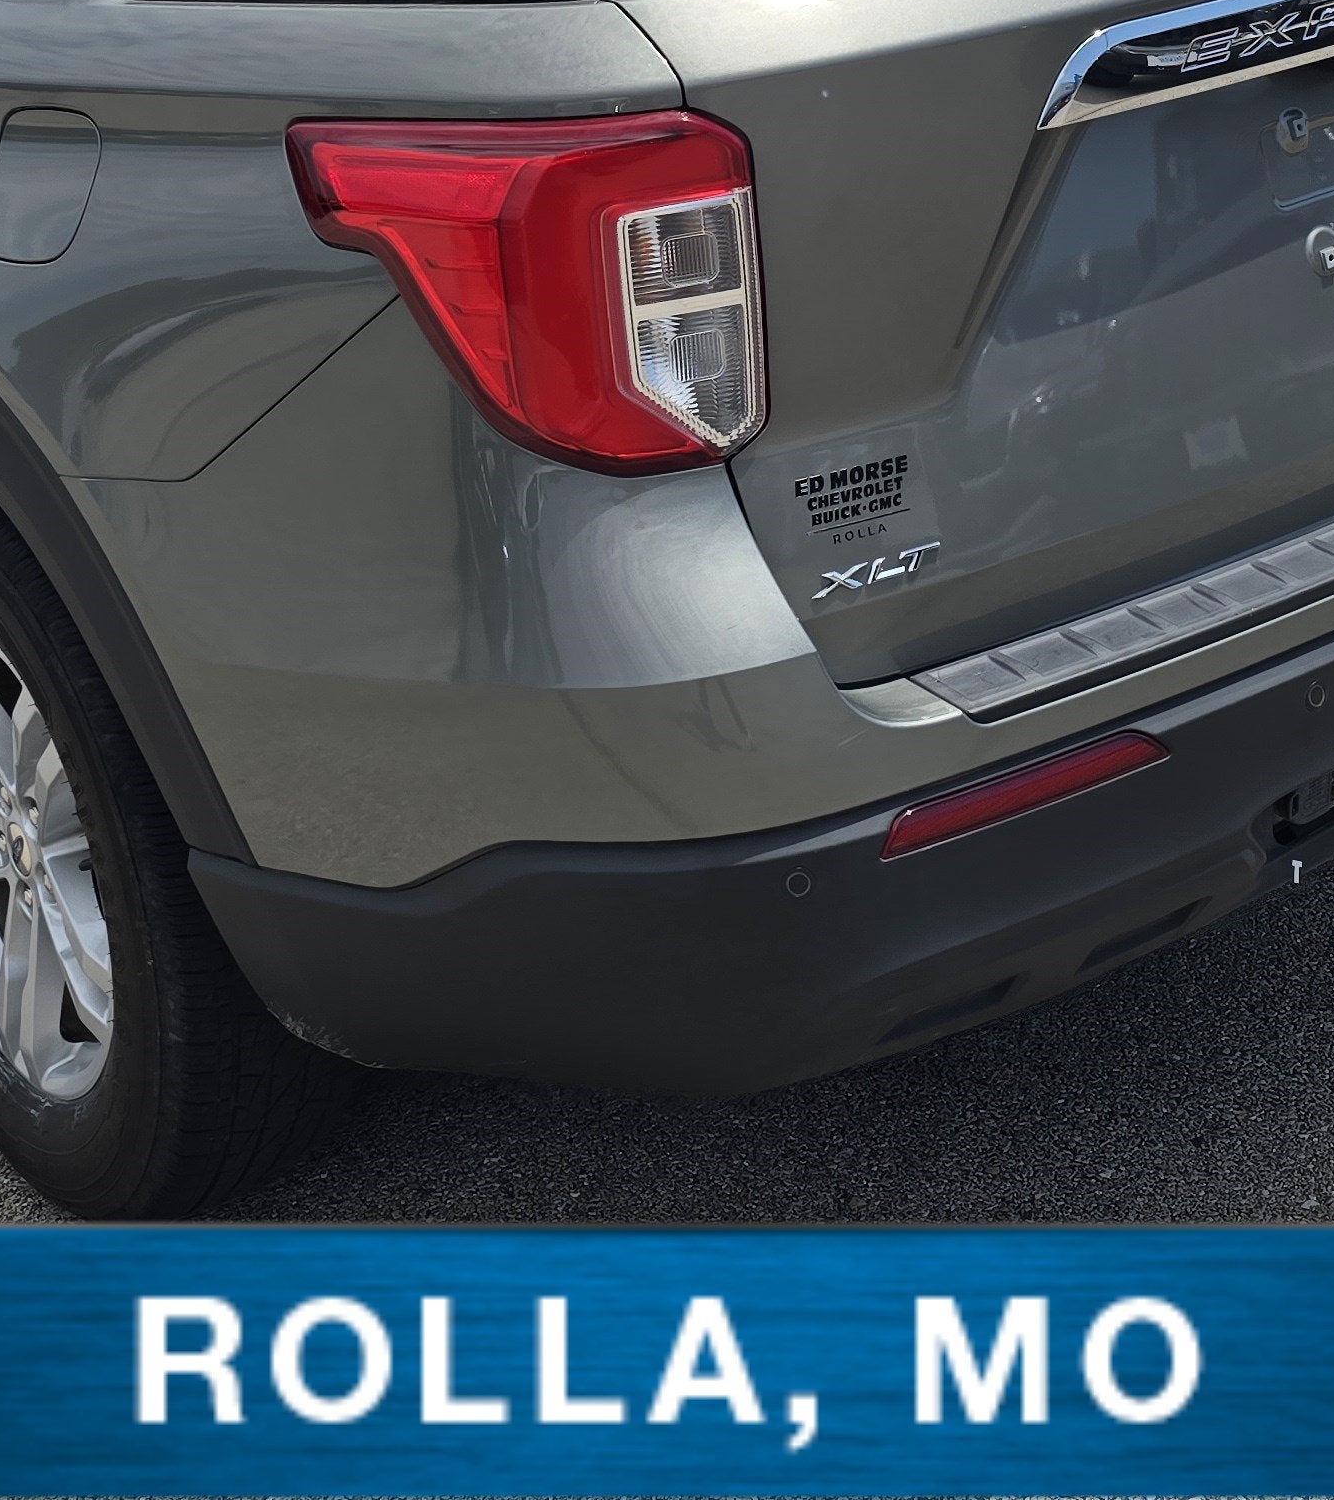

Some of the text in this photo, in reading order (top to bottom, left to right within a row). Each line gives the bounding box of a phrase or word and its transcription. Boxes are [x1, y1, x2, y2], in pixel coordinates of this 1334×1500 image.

[794, 454, 909, 498] ED MORSE
[807, 475, 904, 512] CHEVROLET
[832, 522, 888, 545] ROLLA
[811, 541, 941, 600] XLT
